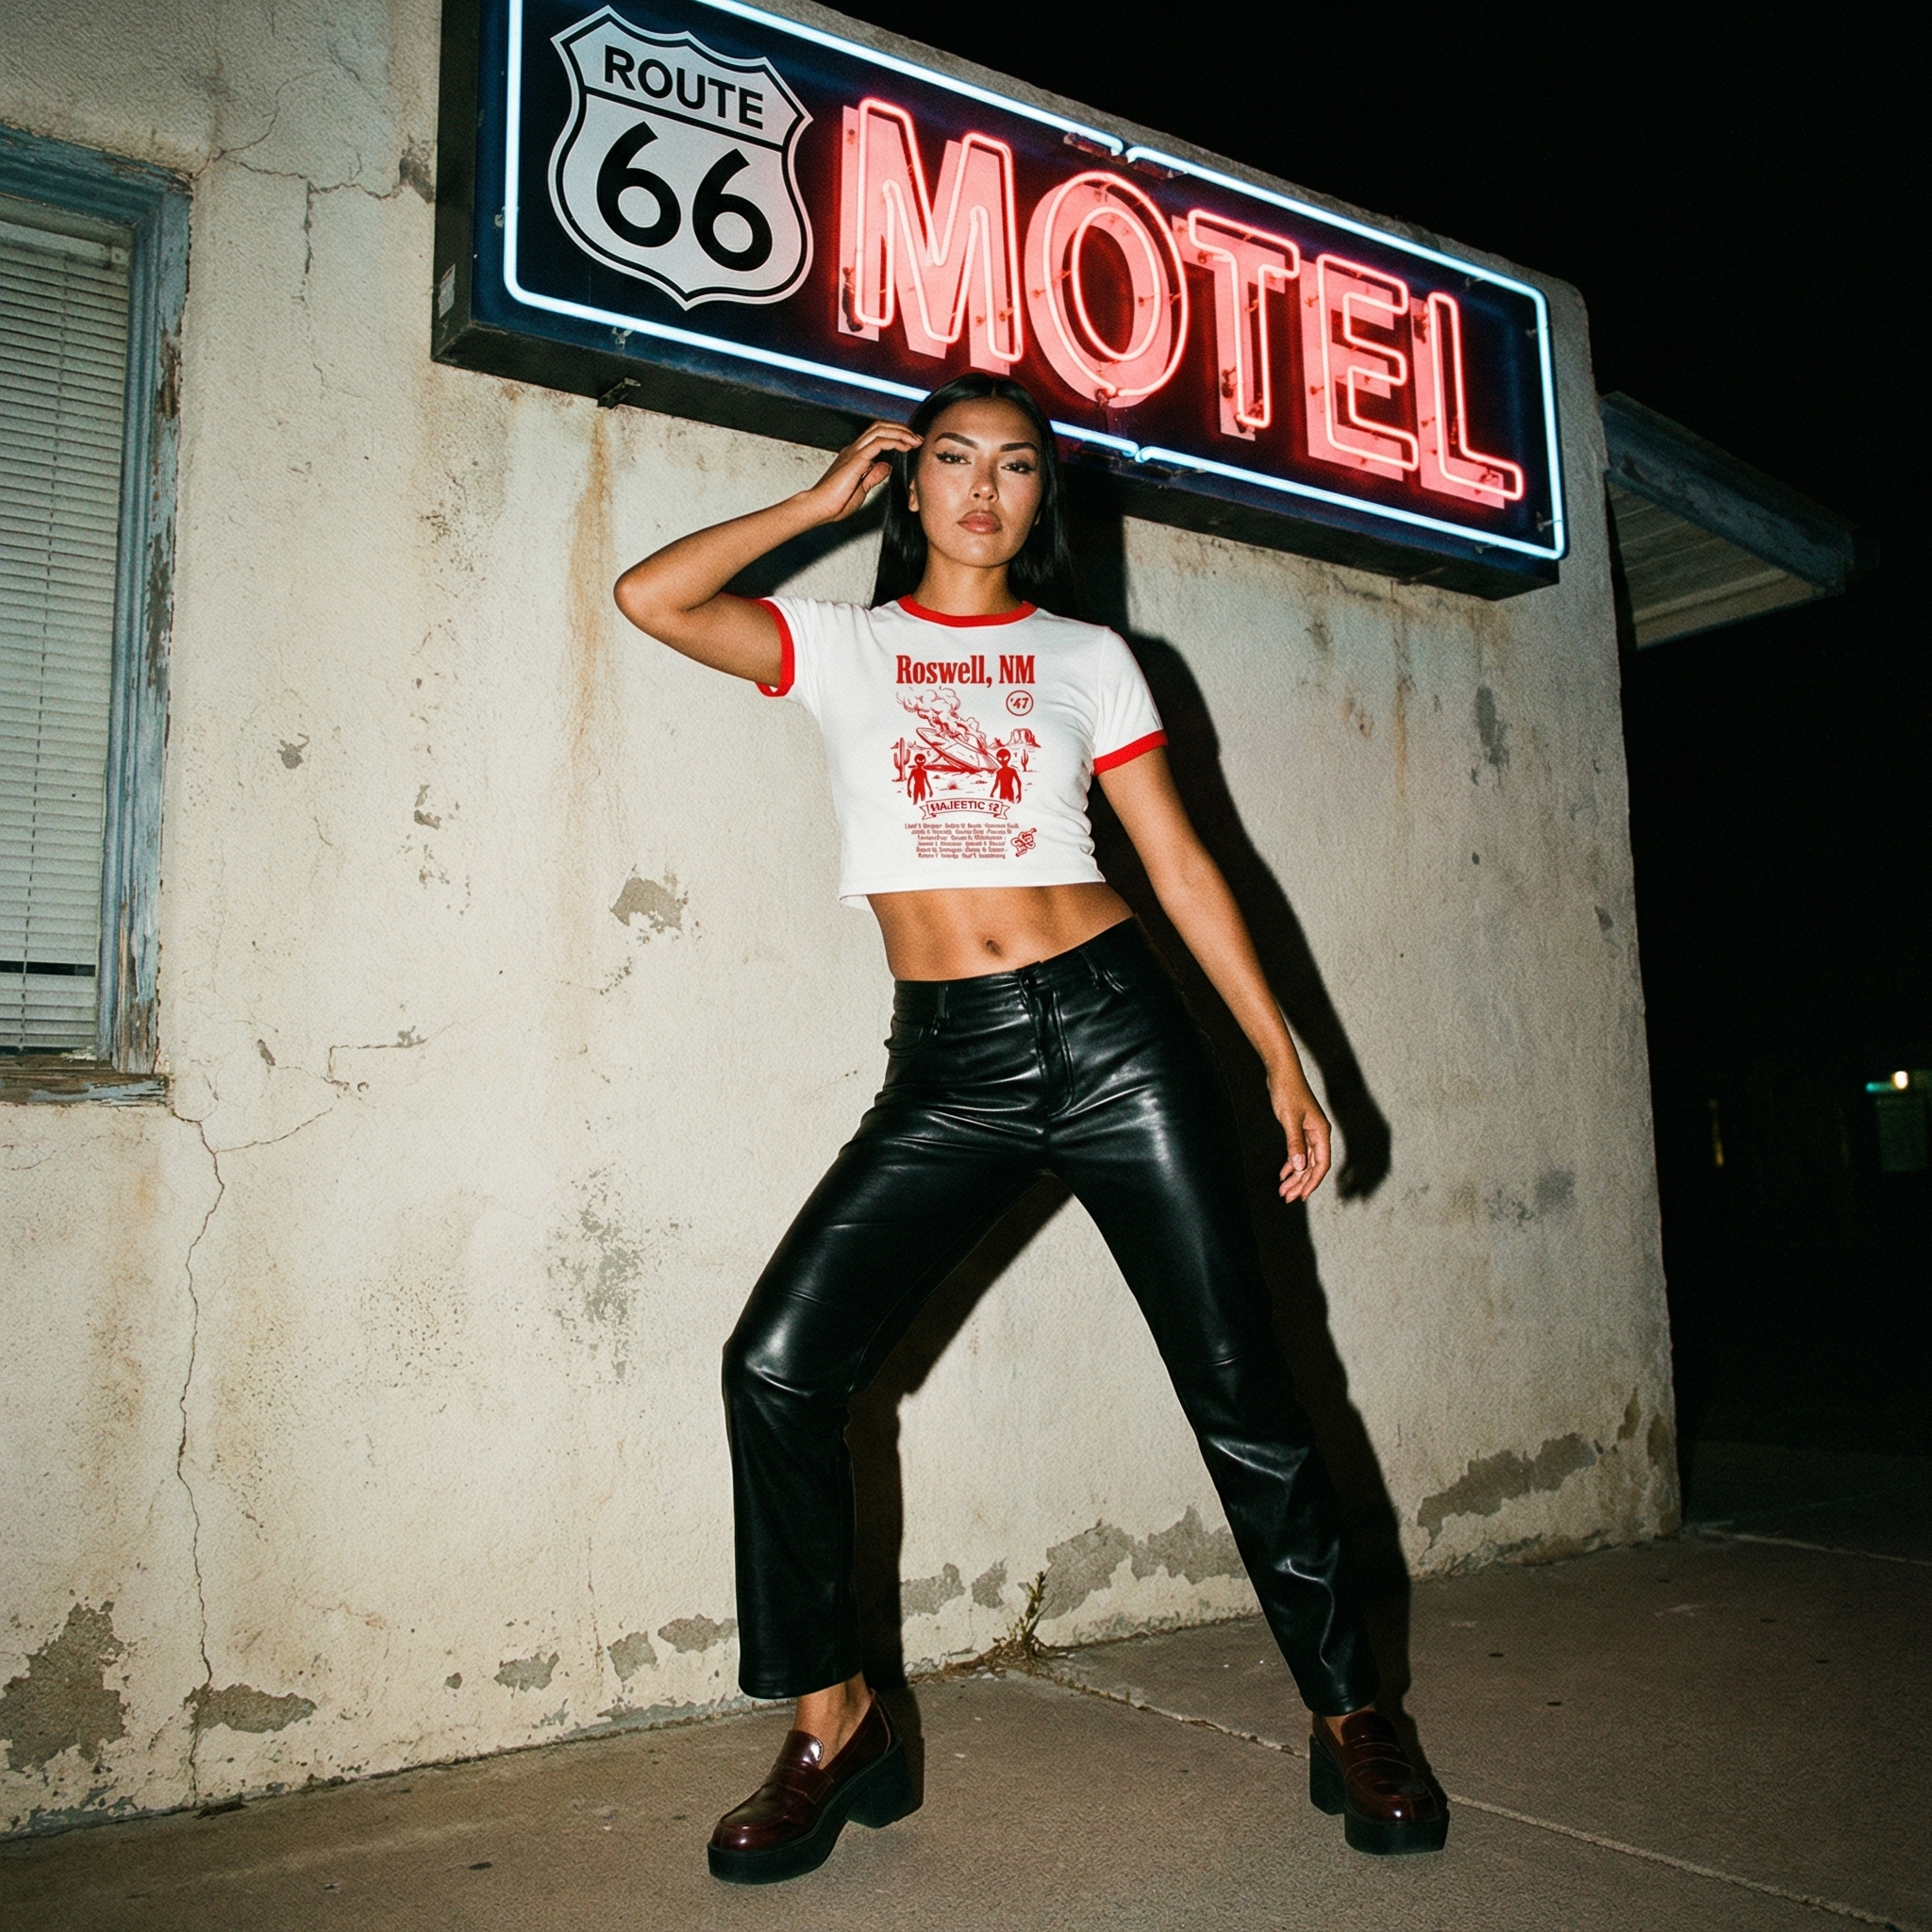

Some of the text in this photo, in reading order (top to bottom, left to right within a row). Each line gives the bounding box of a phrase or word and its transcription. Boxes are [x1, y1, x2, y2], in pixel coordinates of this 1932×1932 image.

[604, 44, 763, 130] ROUTE
[596, 121, 773, 272] 66
[838, 98, 1524, 508] MOTEL
[896, 655, 1035, 687] Roswell, NM
